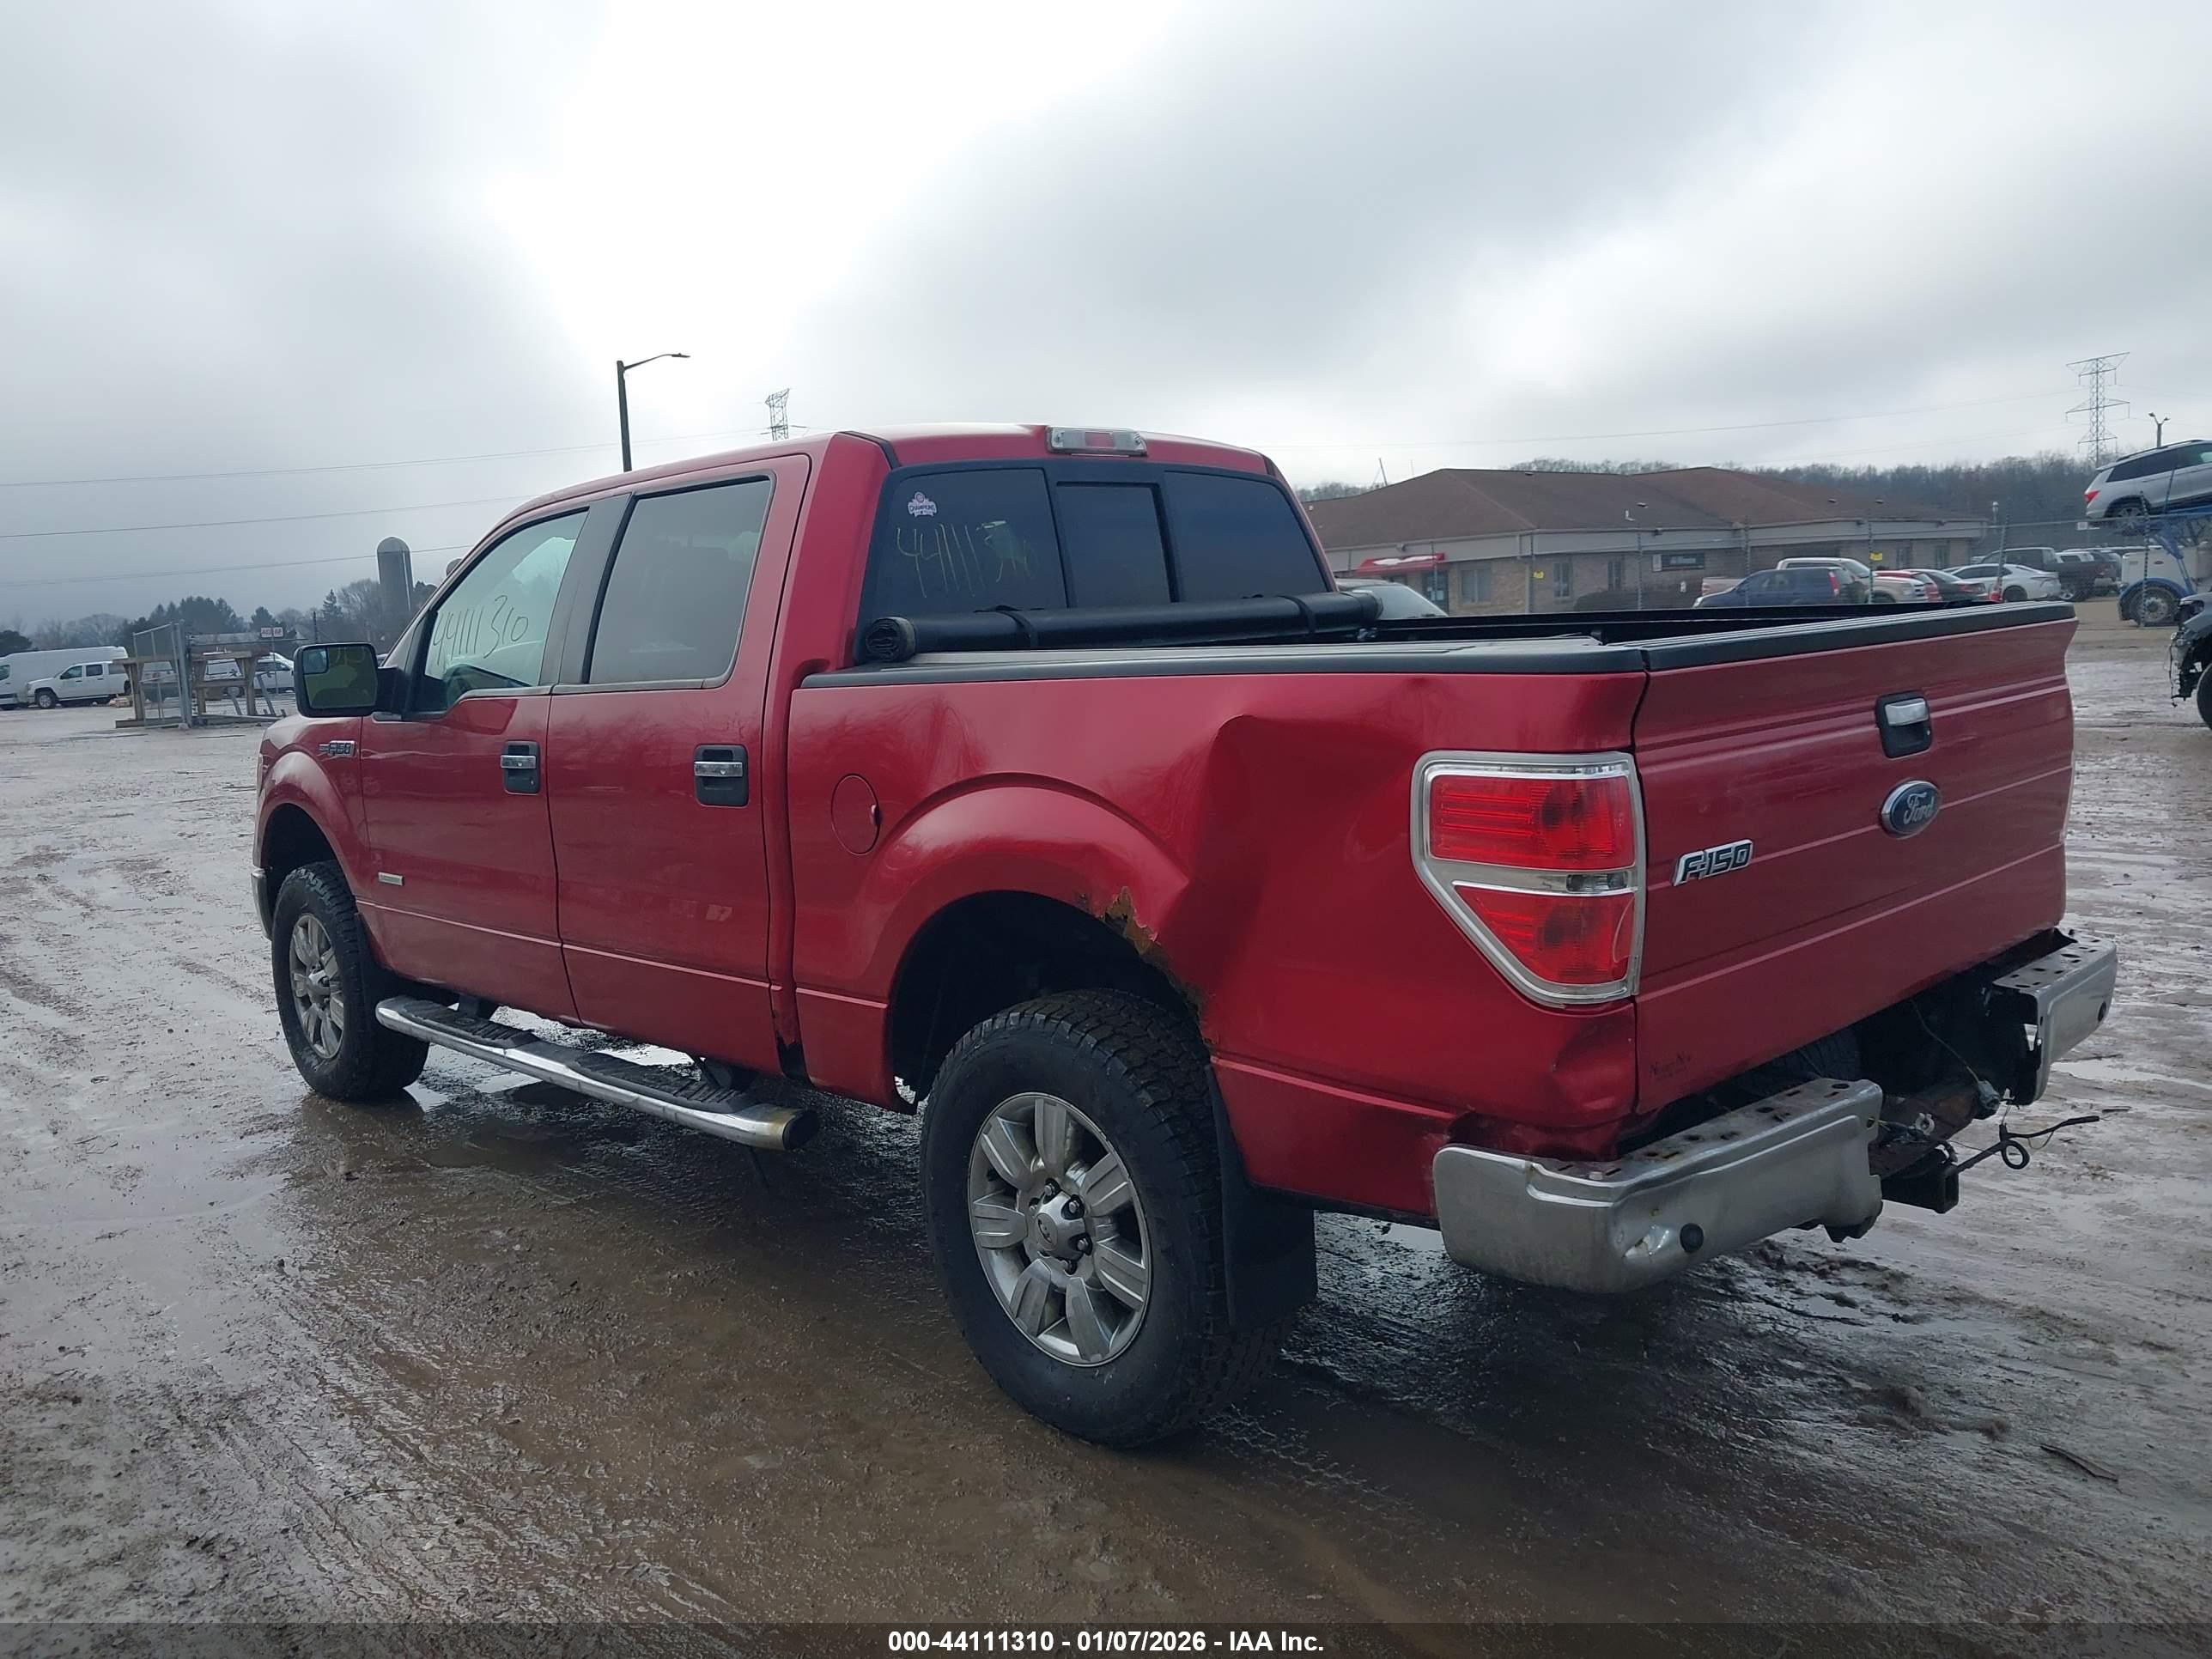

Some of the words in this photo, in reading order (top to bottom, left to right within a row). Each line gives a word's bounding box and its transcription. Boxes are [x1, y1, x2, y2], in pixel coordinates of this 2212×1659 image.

[433, 594, 529, 666] 44111310
[1903, 792, 1935, 824] Ford
[1674, 839, 1753, 886] F-150
